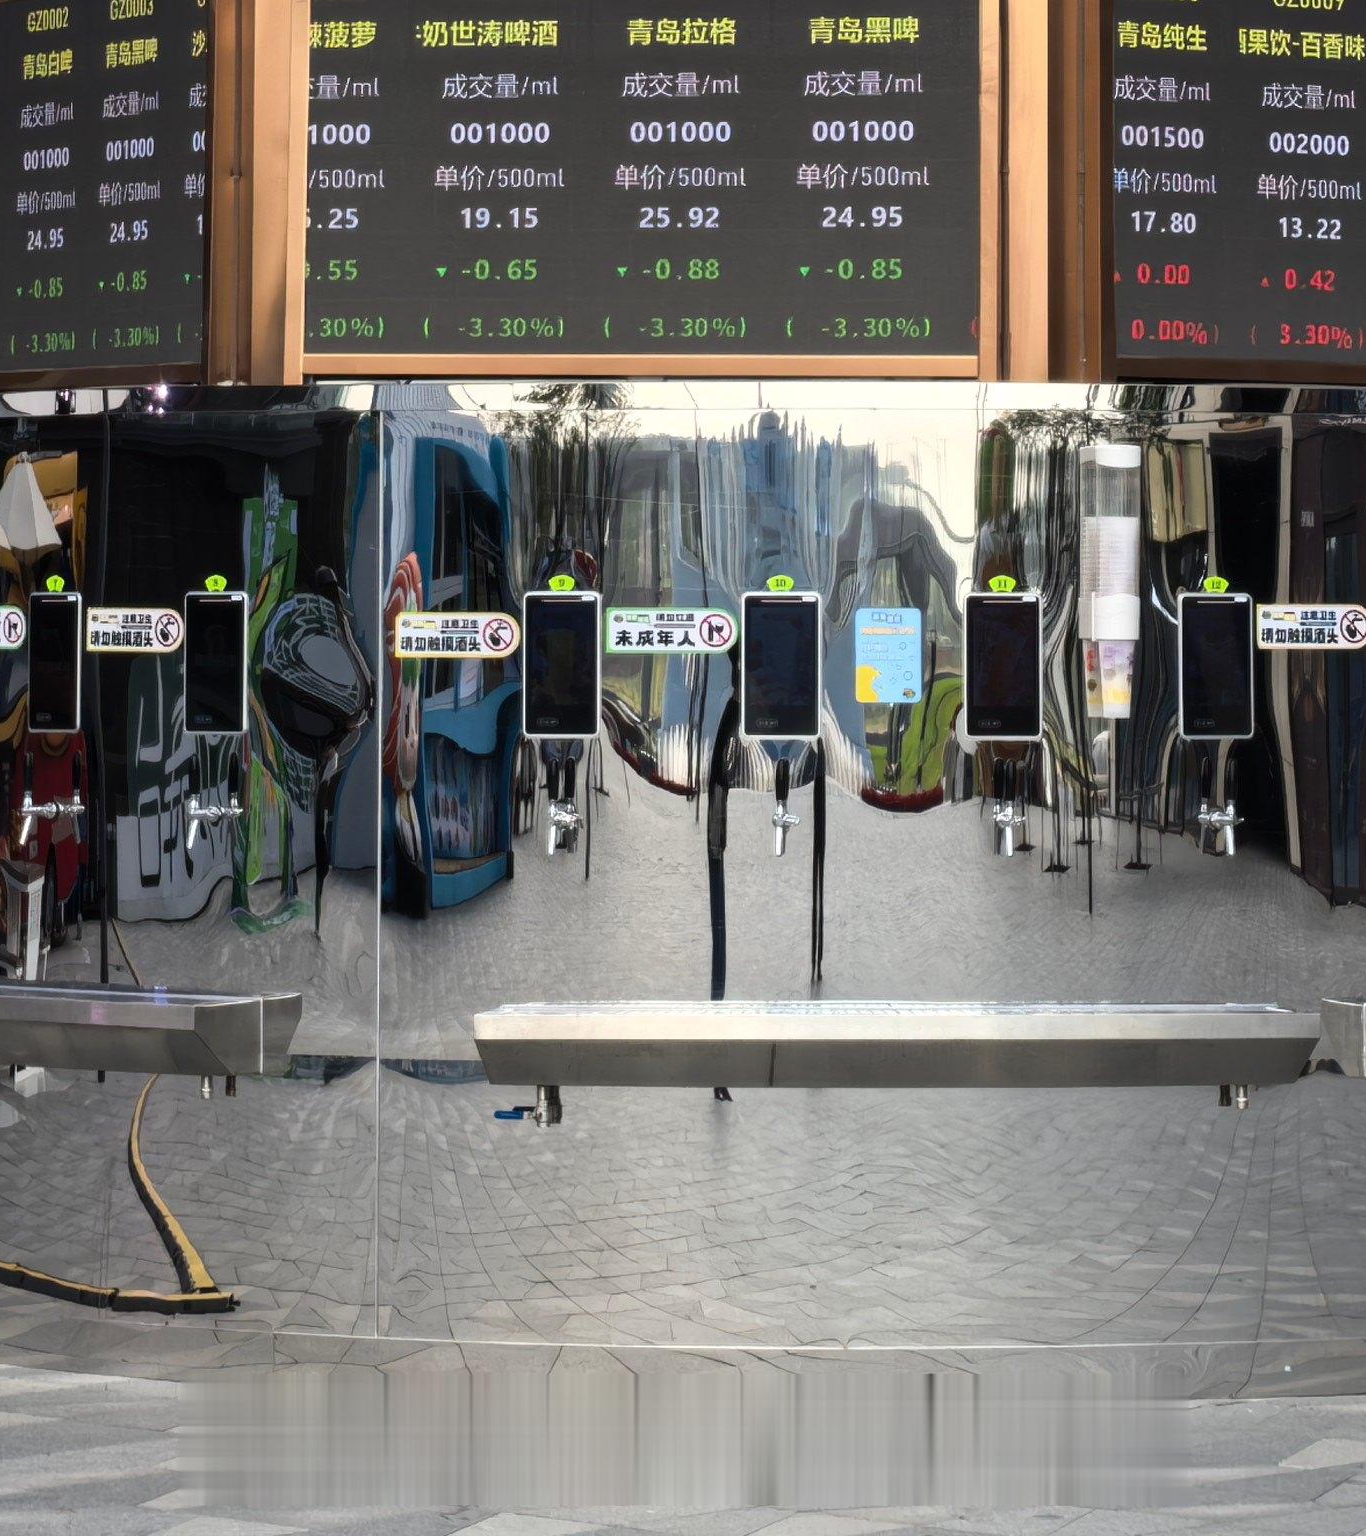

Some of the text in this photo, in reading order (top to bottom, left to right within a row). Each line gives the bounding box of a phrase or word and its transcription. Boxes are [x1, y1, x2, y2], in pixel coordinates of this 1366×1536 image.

[27, 6, 69, 33] GZ0002
[626, 17, 737, 46] 青岛拉格
[809, 15, 920, 45] 青岛黑啤
[415, 19, 559, 48] 奶世涛啤酒
[1117, 20, 1208, 51] 青岛纯生
[22, 48, 73, 80] 青岛白啤
[105, 37, 158, 69] 青岛黑啤
[441, 72, 559, 100] 成交量/ml
[621, 71, 740, 98] 成交量/ml
[804, 70, 923, 97] 成交量/ml
[1113, 74, 1211, 102] 成交量/ml
[1261, 82, 1356, 110] 成交量/ml
[20, 101, 74, 129] 成交量/ml
[102, 90, 159, 119] 成交量/ml
[450, 122, 550, 144] 001000
[629, 121, 732, 143] 001000
[812, 120, 914, 142] 001000
[1121, 124, 1204, 150] 001500
[105, 136, 155, 162] 001000
[1269, 131, 1350, 157] 002000
[23, 146, 70, 171] 001000
[309, 168, 385, 189] /500ml
[434, 165, 565, 192] 单价/500ml
[614, 164, 747, 191] 单价/500ml
[796, 163, 930, 190] 单价/500ml
[1113, 167, 1217, 194] 单价/500ml
[1256, 173, 1362, 201] 单价/500ml
[16, 190, 76, 216] 单价/500ml
[98, 180, 161, 207] 单价/500ml
[460, 207, 539, 229] 19.15
[639, 206, 720, 229] 25.92
[821, 205, 903, 228] 24.95
[1131, 210, 1197, 234] 17.80
[1279, 216, 1342, 240] 13.22
[27, 227, 64, 251] 24.95
[109, 219, 149, 244] 24.95
[110, 269, 148, 293] -0.85
[461, 258, 538, 281] -0.65
[642, 258, 720, 281] -0.88
[826, 258, 903, 280] -0.85
[1137, 262, 1190, 286] 0.00
[1284, 268, 1336, 292] 0.42
[28, 276, 64, 299] -0.85
[458, 316, 564, 338] -3.30%)
[639, 316, 746, 338] -3.30%)
[821, 317, 931, 338] -3.30%)
[774, 578, 786, 588] 10
[997, 579, 1008, 589] 11
[615, 630, 696, 647] 未成年人
